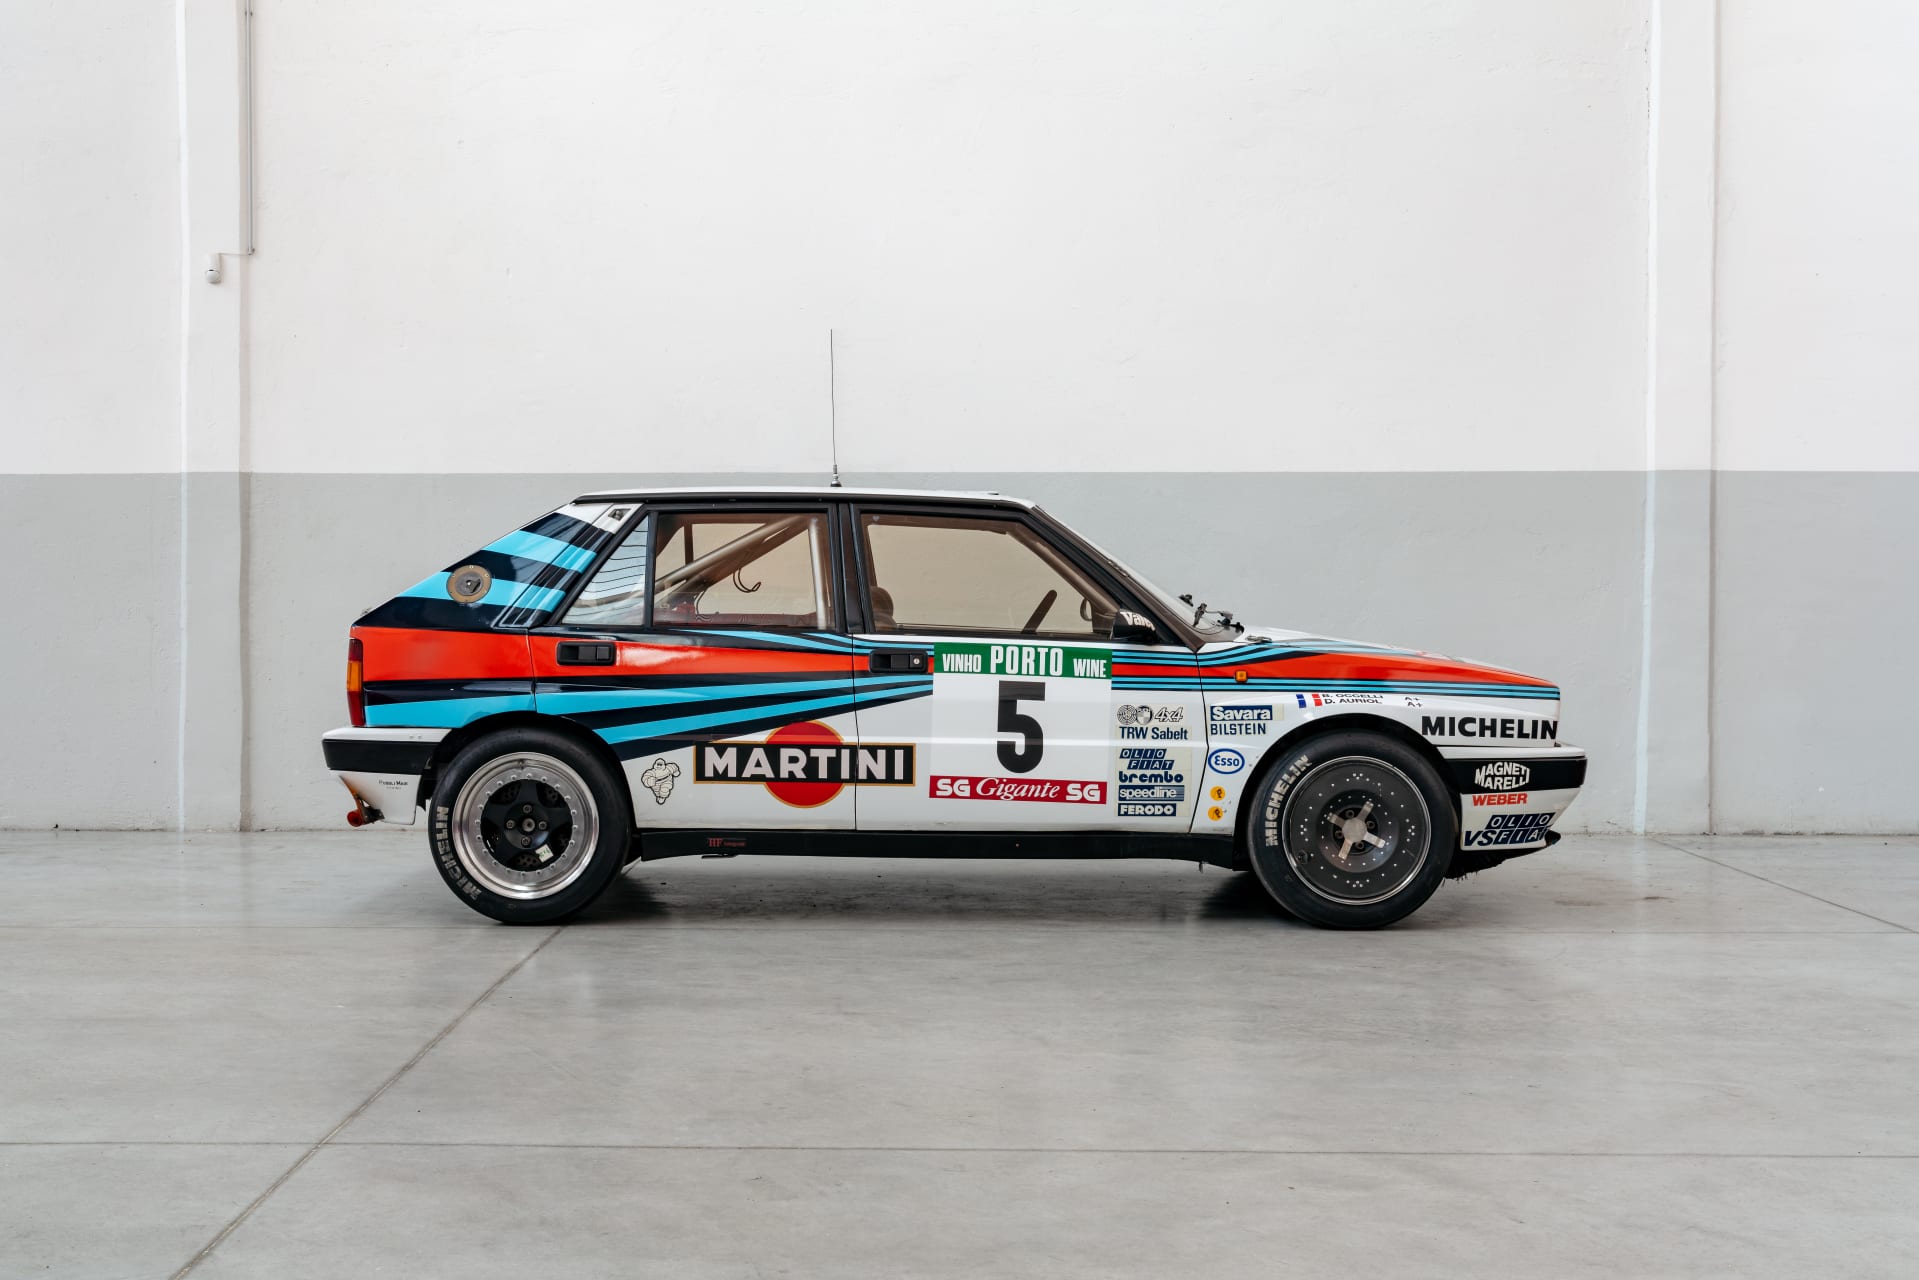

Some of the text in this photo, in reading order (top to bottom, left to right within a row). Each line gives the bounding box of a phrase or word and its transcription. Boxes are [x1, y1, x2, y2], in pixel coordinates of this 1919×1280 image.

[942, 645, 1107, 678] VINHO PORTO WINE
[1154, 706, 1184, 723] 4x4
[1212, 706, 1271, 721] Savara
[996, 680, 1046, 774] 5
[1119, 726, 1188, 740] TRW Sabelt
[1210, 723, 1267, 736] BILSTEIN
[1421, 715, 1558, 740] MICHELIN
[1122, 749, 1165, 758] OLIO
[1214, 755, 1240, 767] Esso
[704, 746, 904, 780] MARTINI
[1130, 760, 1172, 769] FIAT
[1118, 770, 1184, 784] brembo
[1474, 761, 1530, 781] MAGNETI
[1474, 771, 1530, 791] MARELLI
[935, 777, 1101, 802] SG Gigante SG
[1119, 786, 1177, 800] speedline
[1264, 754, 1313, 847] MICHELIN
[1472, 793, 1528, 807] WEBER
[1120, 804, 1174, 815] FERODO
[1490, 814, 1551, 828] OLIO
[435, 806, 483, 901] MICHELIN
